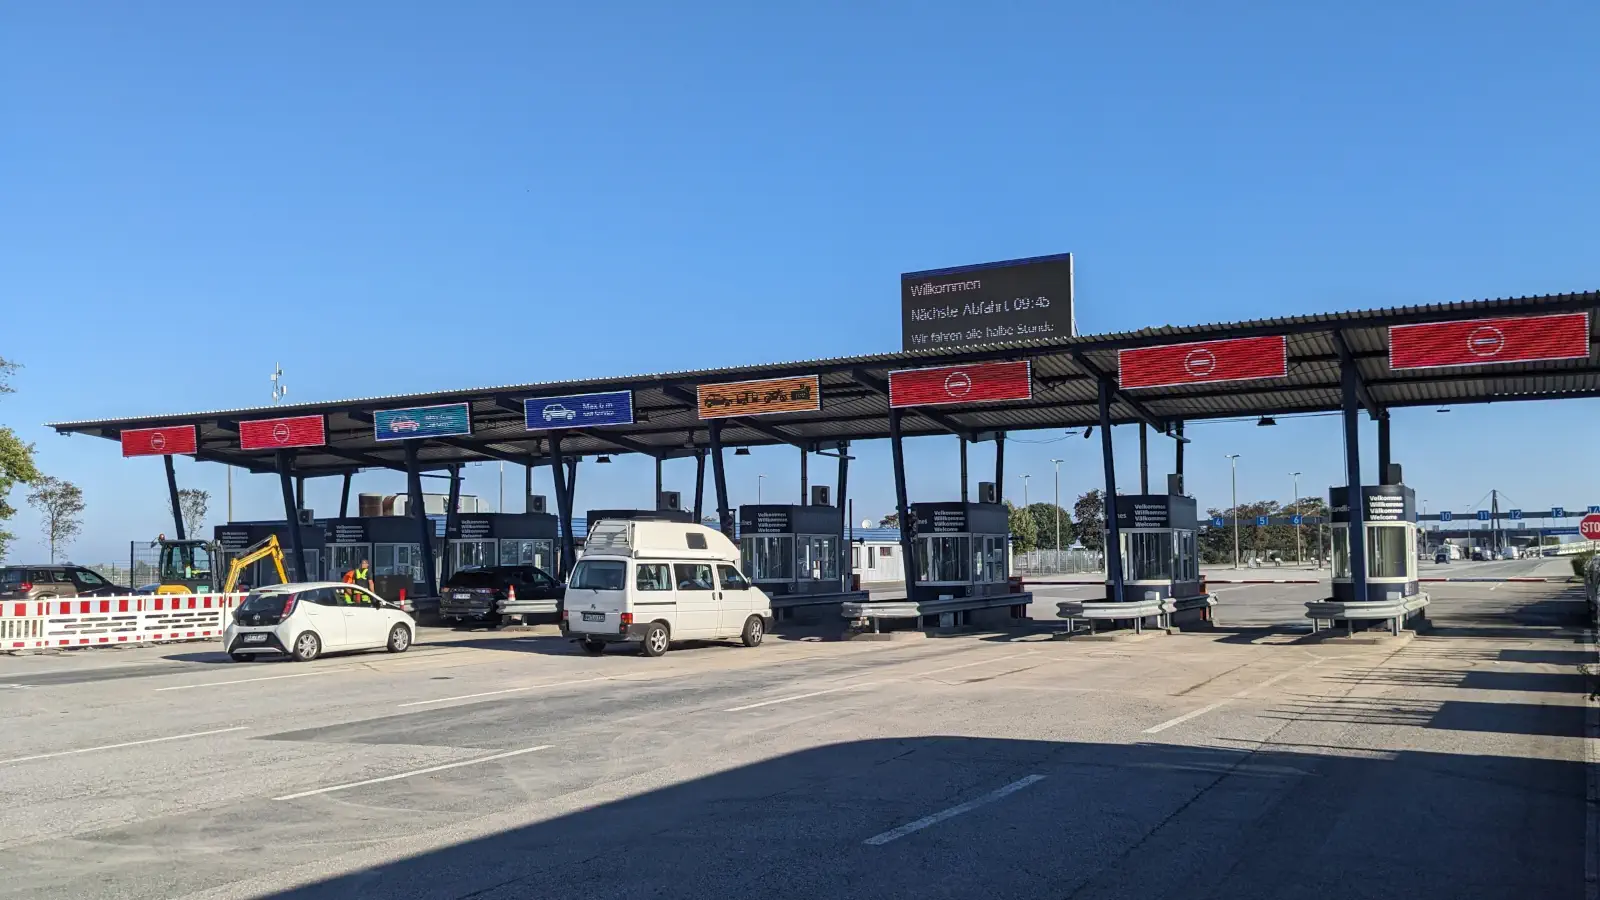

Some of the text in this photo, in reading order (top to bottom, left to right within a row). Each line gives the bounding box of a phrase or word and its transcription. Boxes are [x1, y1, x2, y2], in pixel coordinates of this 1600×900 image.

[911, 280, 981, 296] Willkommen
[911, 296, 1050, 321] Nächste Abfahrt 09:45
[911, 321, 1055, 344] Wir fahren alle halbe Stunde
[1441, 512, 1451, 521] 10
[1480, 511, 1488, 520] 11
[1511, 510, 1521, 519] 12
[1553, 508, 1563, 517] 13
[1582, 521, 1600, 533] STO
